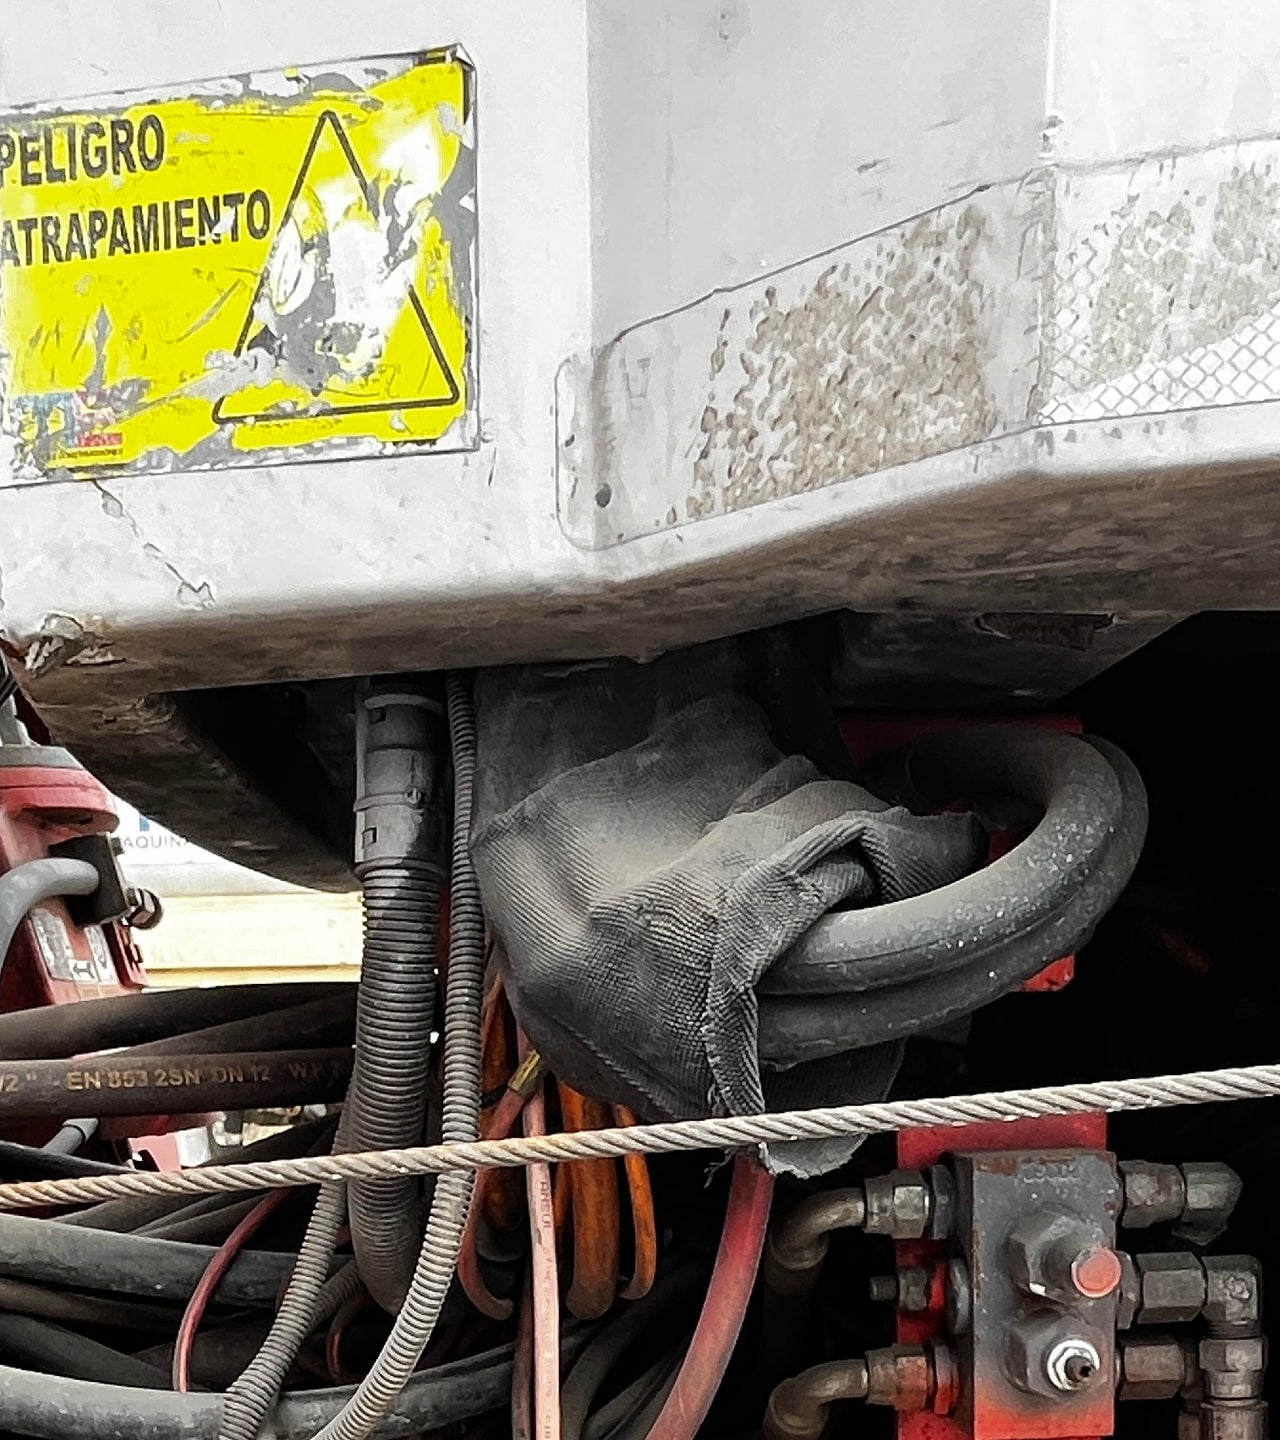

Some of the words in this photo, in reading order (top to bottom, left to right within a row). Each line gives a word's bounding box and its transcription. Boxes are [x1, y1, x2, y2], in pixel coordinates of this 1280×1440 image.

[1, 189, 271, 267] ATRAPAMIENTO
[67, 1071, 101, 1090] EN
[108, 1070, 149, 1088] 853
[155, 1068, 200, 1087] 2SN
